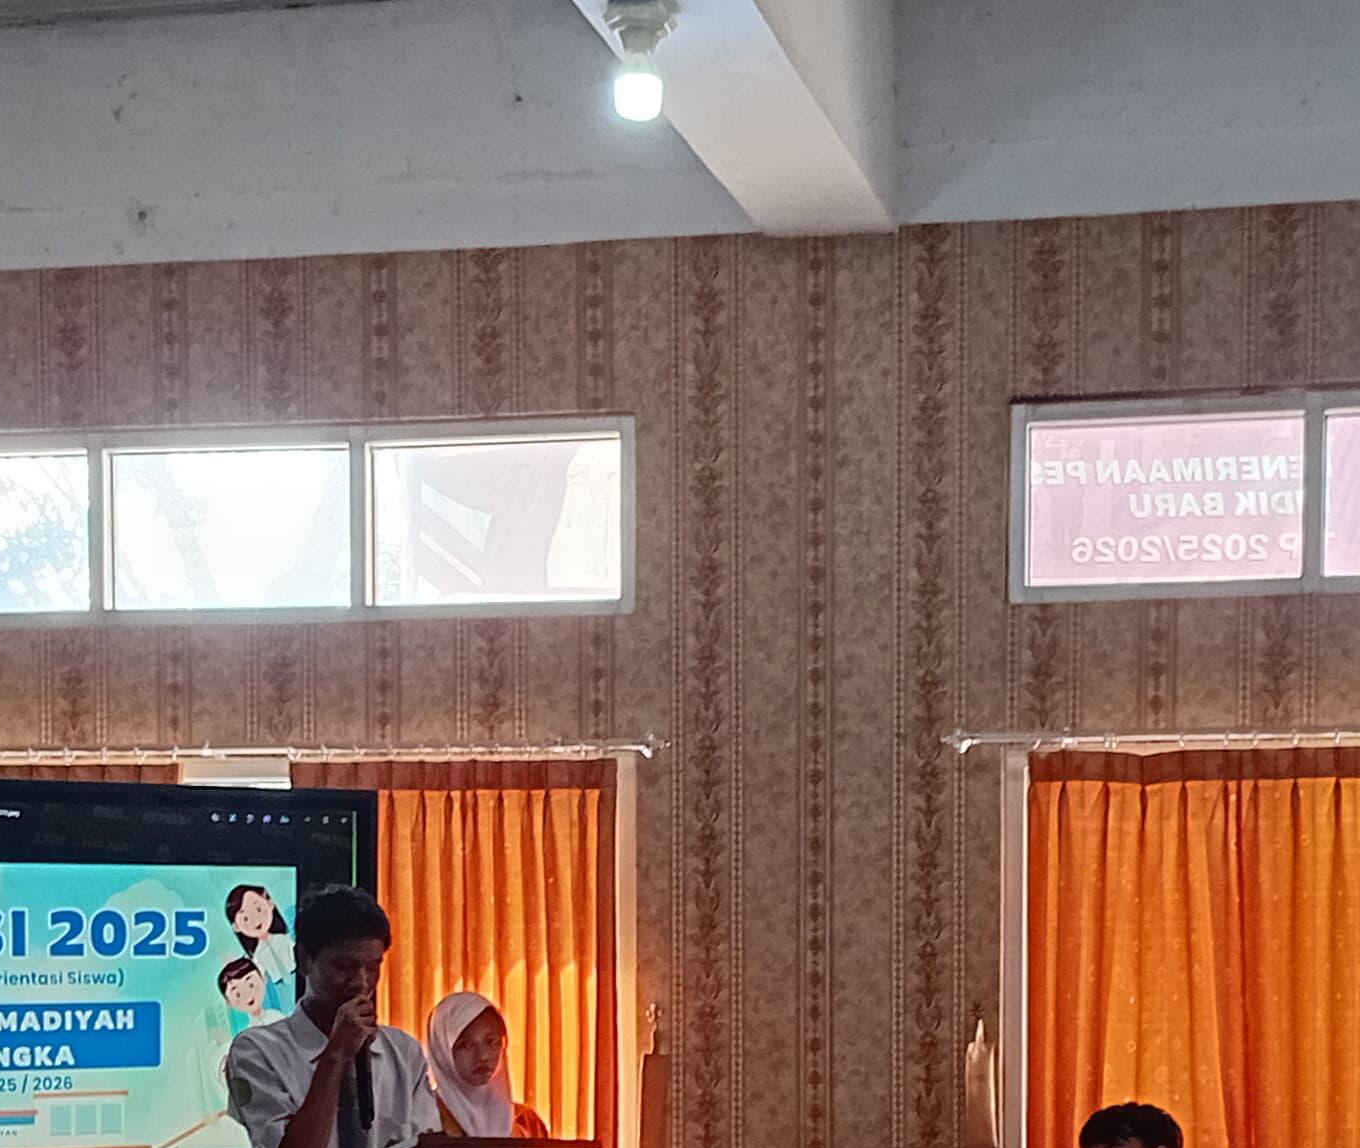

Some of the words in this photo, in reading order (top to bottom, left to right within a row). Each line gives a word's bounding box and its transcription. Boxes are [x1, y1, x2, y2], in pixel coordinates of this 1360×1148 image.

[48, 908, 209, 958] 2025
[67, 968, 124, 987] Siswa)
[21, 1074, 29, 1095] /
[33, 1076, 73, 1091] 2026
